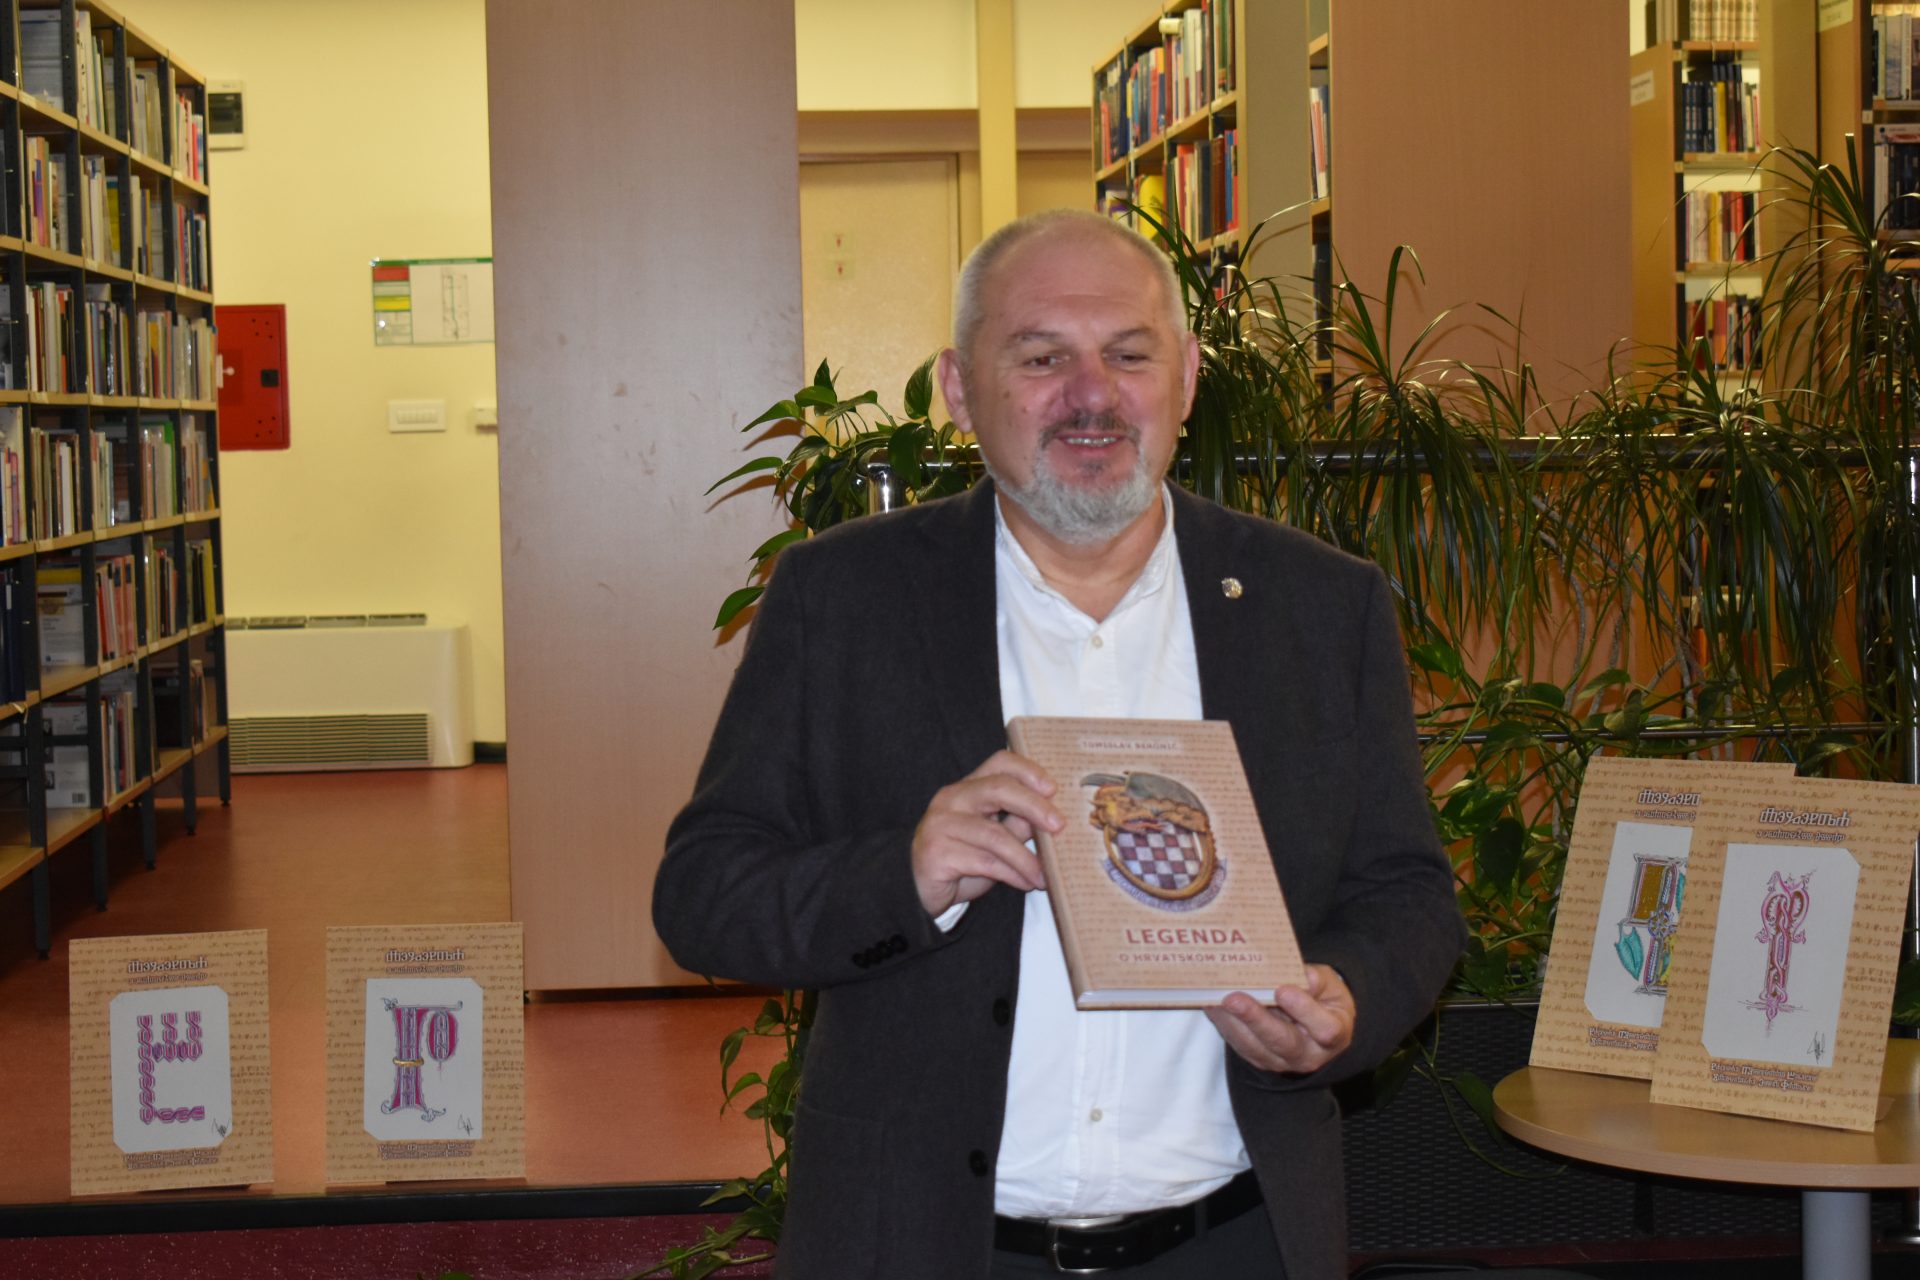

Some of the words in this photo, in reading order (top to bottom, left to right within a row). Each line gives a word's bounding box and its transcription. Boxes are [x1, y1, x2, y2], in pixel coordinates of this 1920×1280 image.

[1125, 929, 1247, 945] LEGENDA
[1119, 953, 1129, 962] O
[1134, 953, 1216, 962] HRVATSKOM
[1221, 954, 1263, 963] ZMAJU
